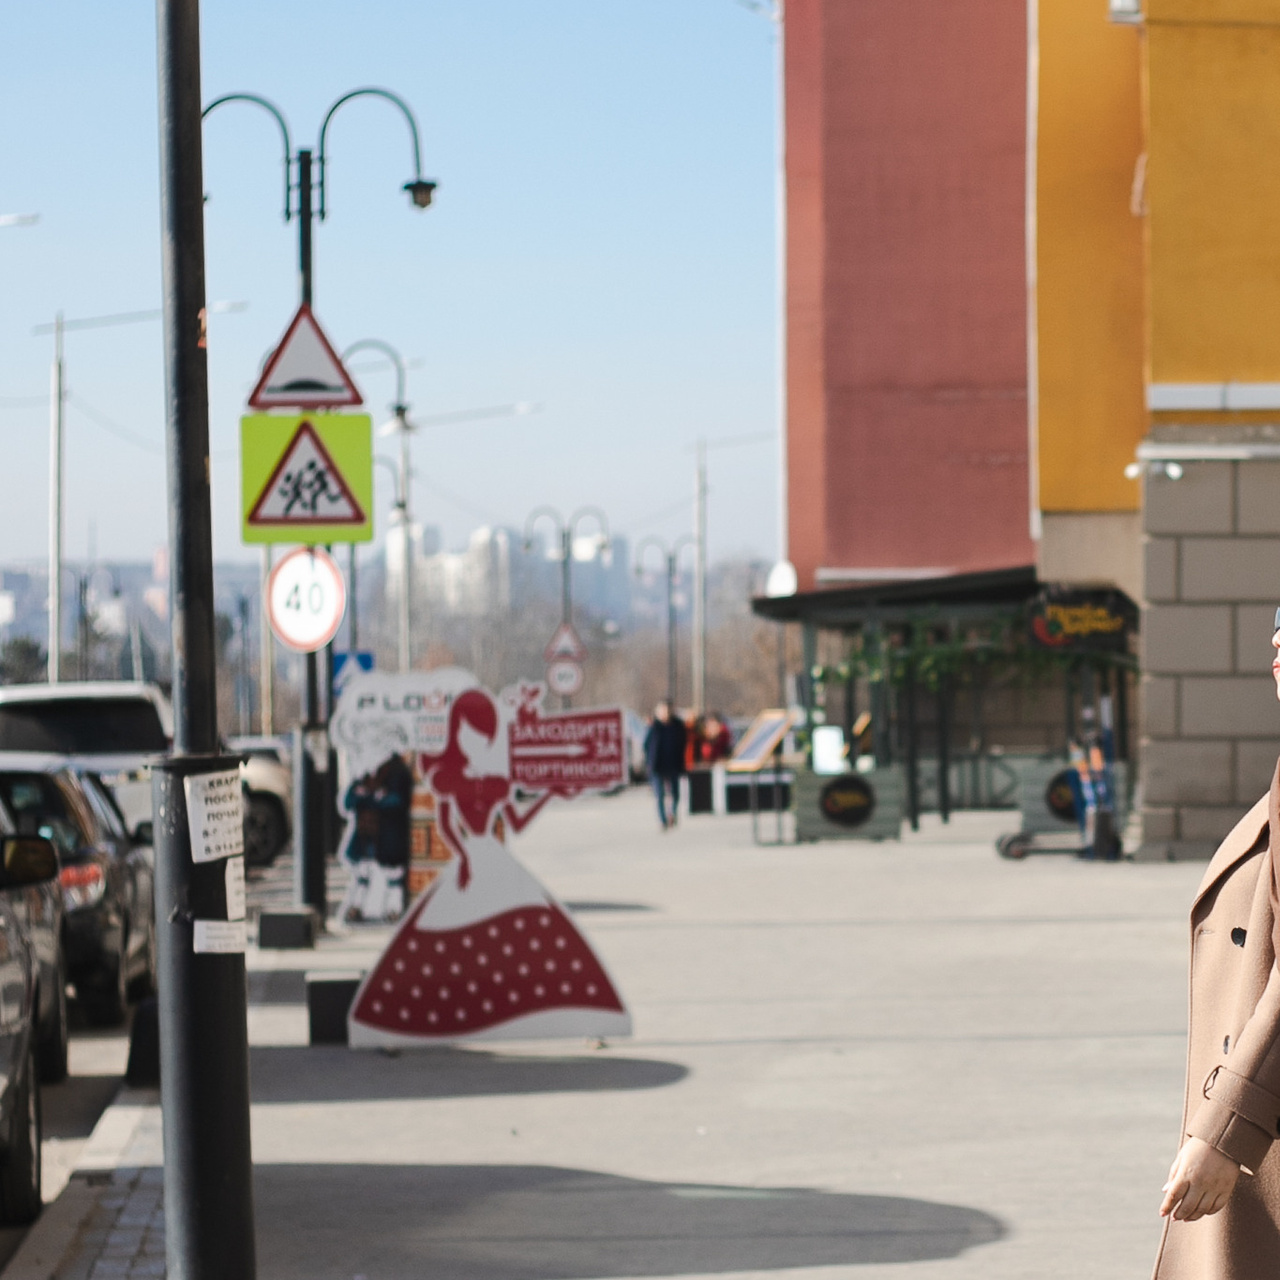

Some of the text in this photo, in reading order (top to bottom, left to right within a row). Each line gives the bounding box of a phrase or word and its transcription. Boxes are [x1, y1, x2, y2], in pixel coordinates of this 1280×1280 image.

[285, 582, 324, 615] 40
[514, 721, 619, 741] ЗАХОДИТЕ
[596, 740, 618, 757] ЗА
